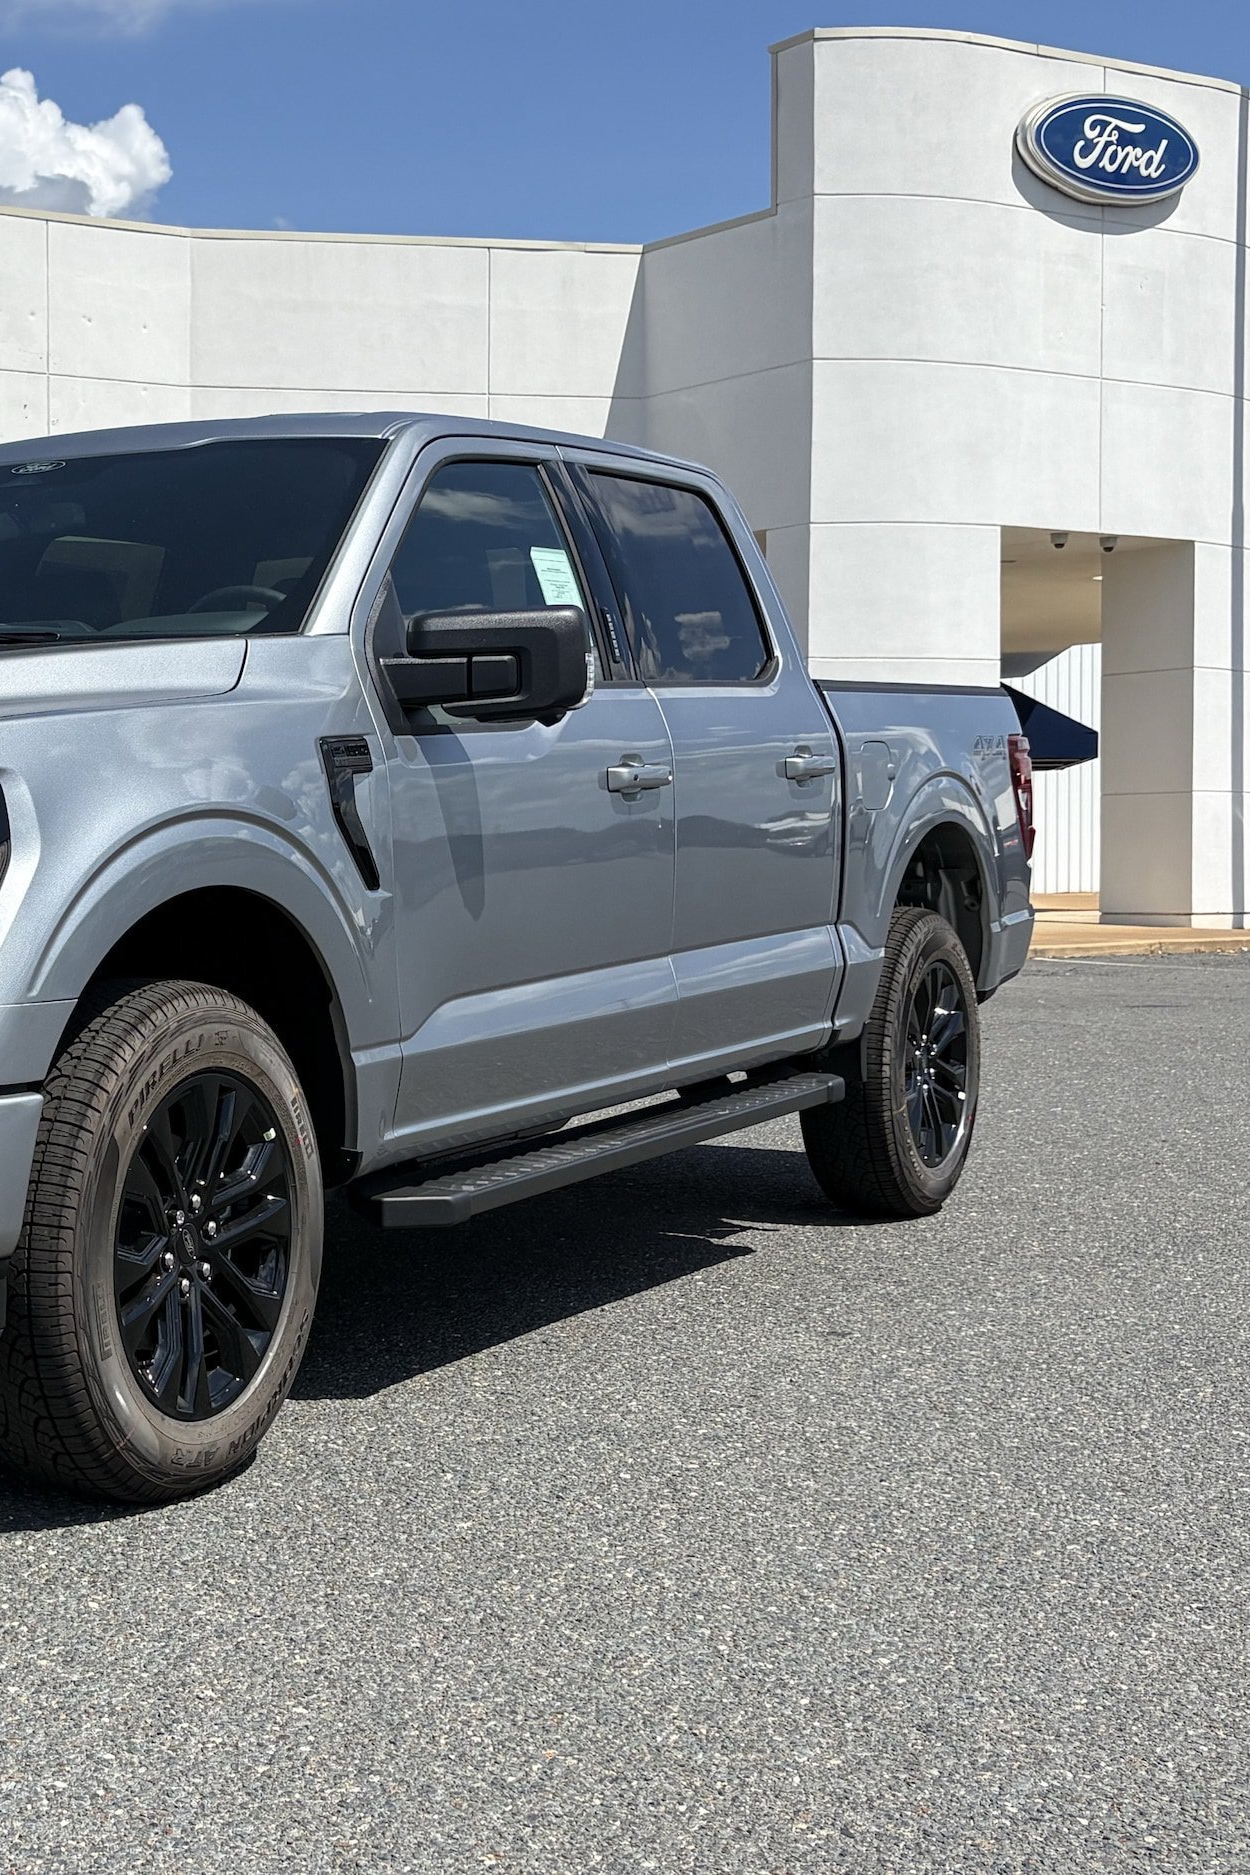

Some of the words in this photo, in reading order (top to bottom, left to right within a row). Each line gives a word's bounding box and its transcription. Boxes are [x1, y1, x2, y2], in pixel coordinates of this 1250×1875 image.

[1073, 113, 1168, 179] Ford
[128, 1033, 205, 1128] PIRELLI
[170, 1446, 221, 1468] ATR
